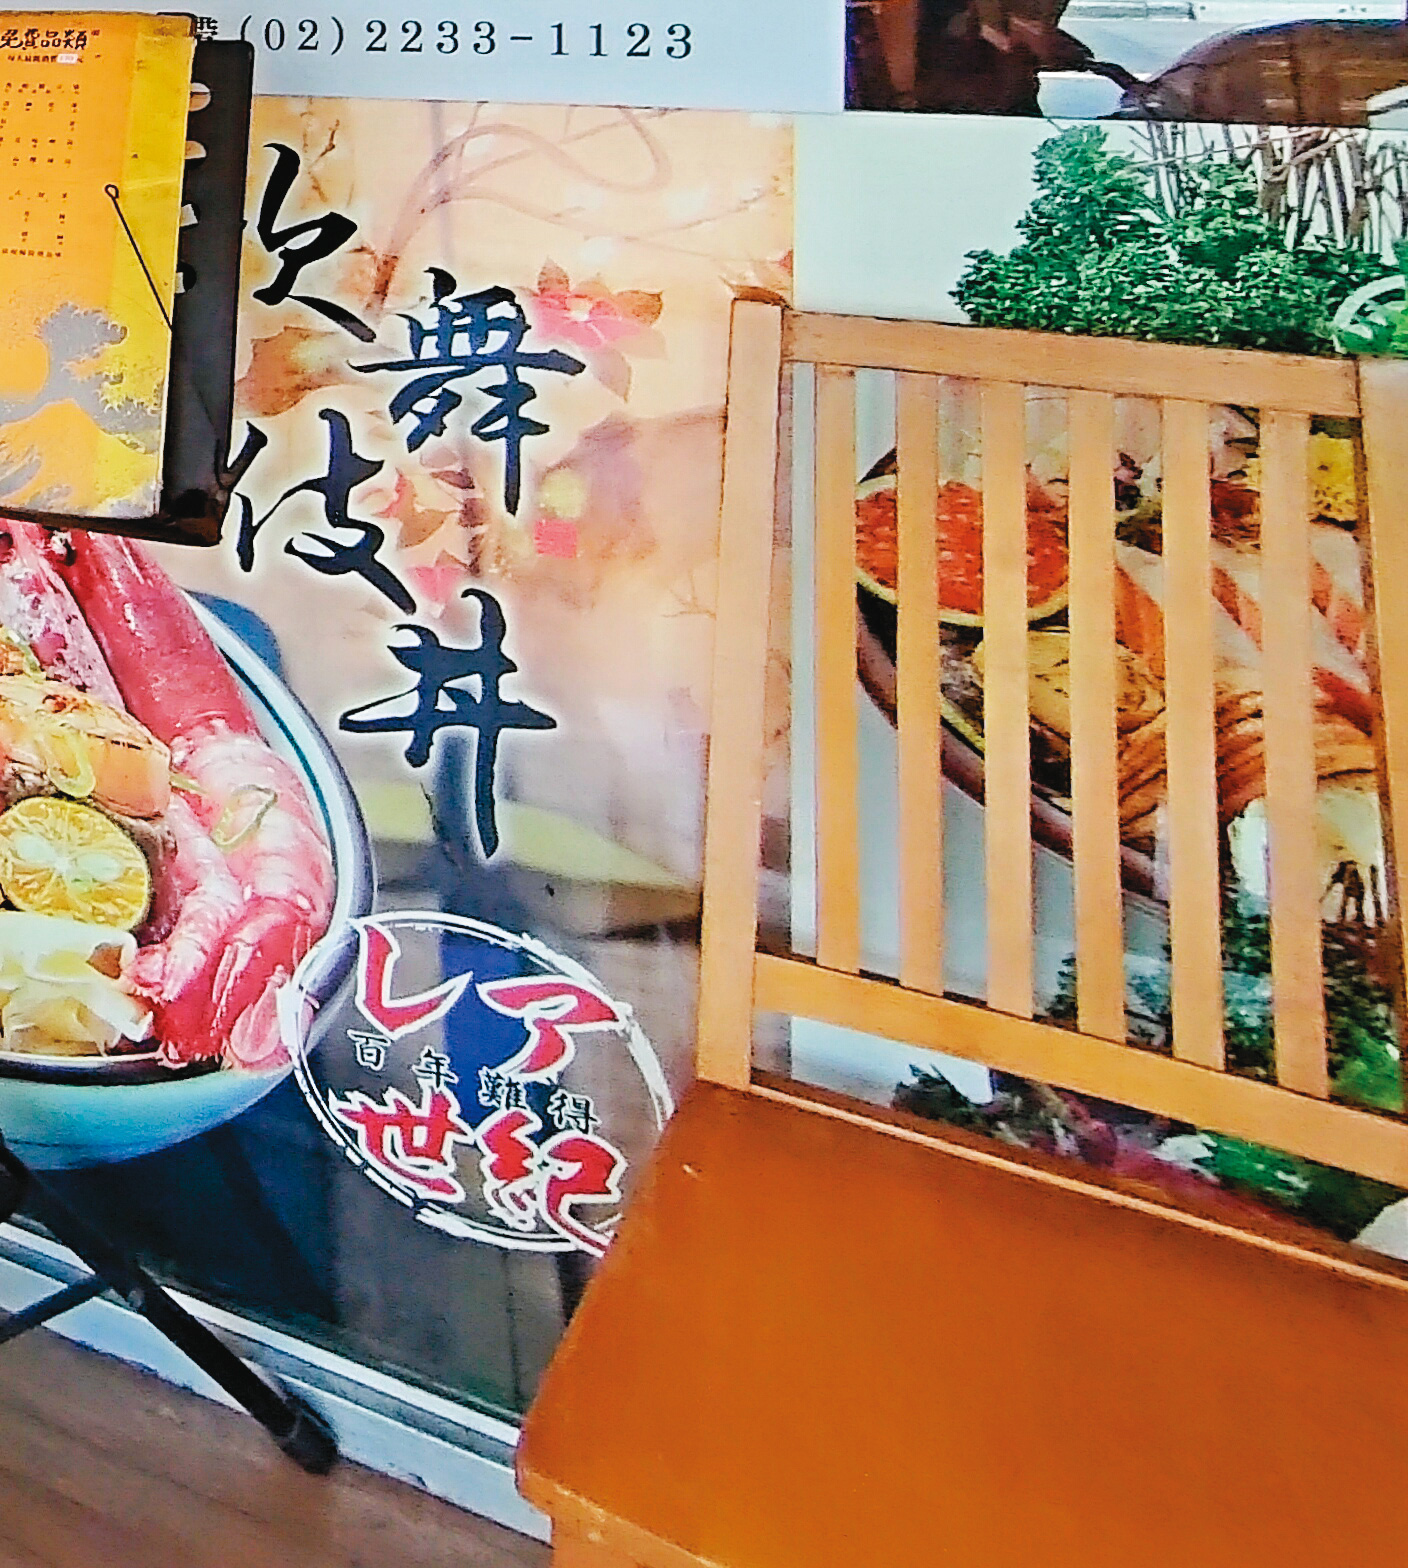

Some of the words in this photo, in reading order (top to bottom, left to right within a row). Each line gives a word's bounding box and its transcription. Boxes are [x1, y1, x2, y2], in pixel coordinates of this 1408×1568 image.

[240, 13, 695, 60] (02)2233-1123
[348, 1028, 602, 1138] 百年難得
